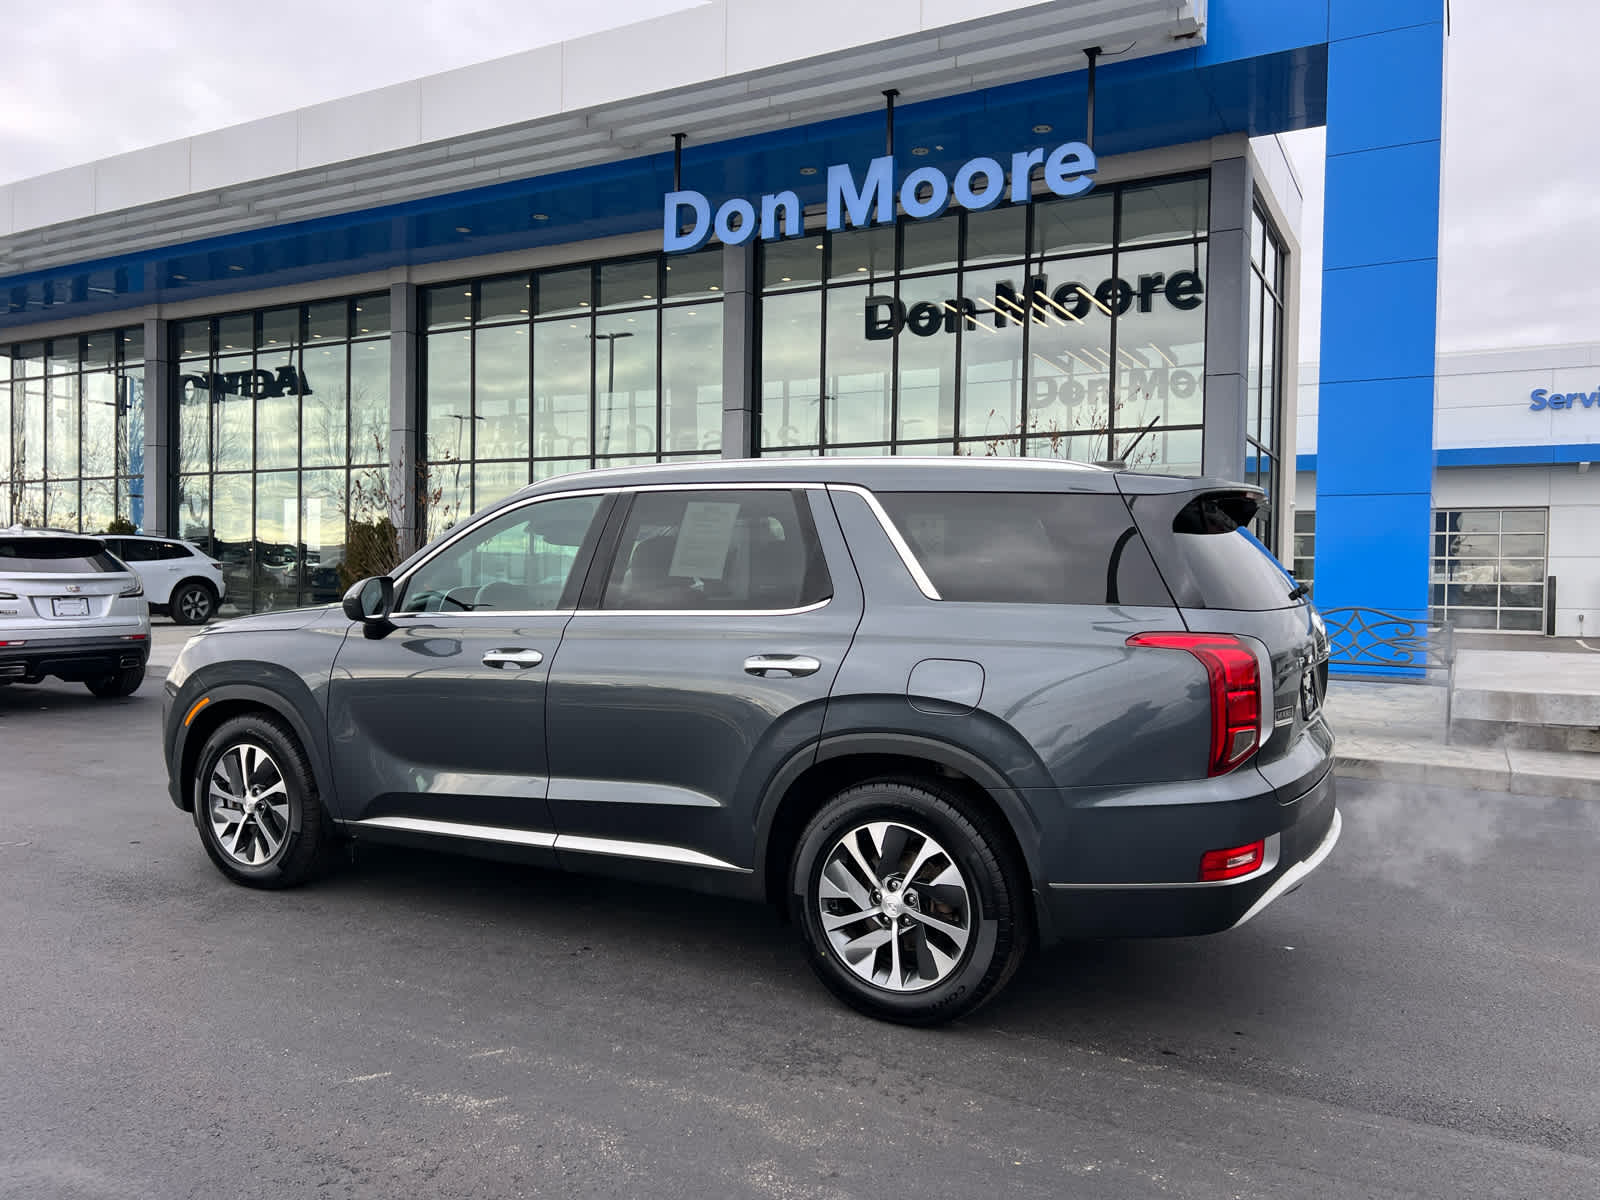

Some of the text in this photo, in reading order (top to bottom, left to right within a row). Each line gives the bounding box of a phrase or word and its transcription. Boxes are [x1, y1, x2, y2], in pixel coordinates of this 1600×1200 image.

[663, 140, 1098, 253] Don Moore
[864, 270, 1204, 341] Don Moore
